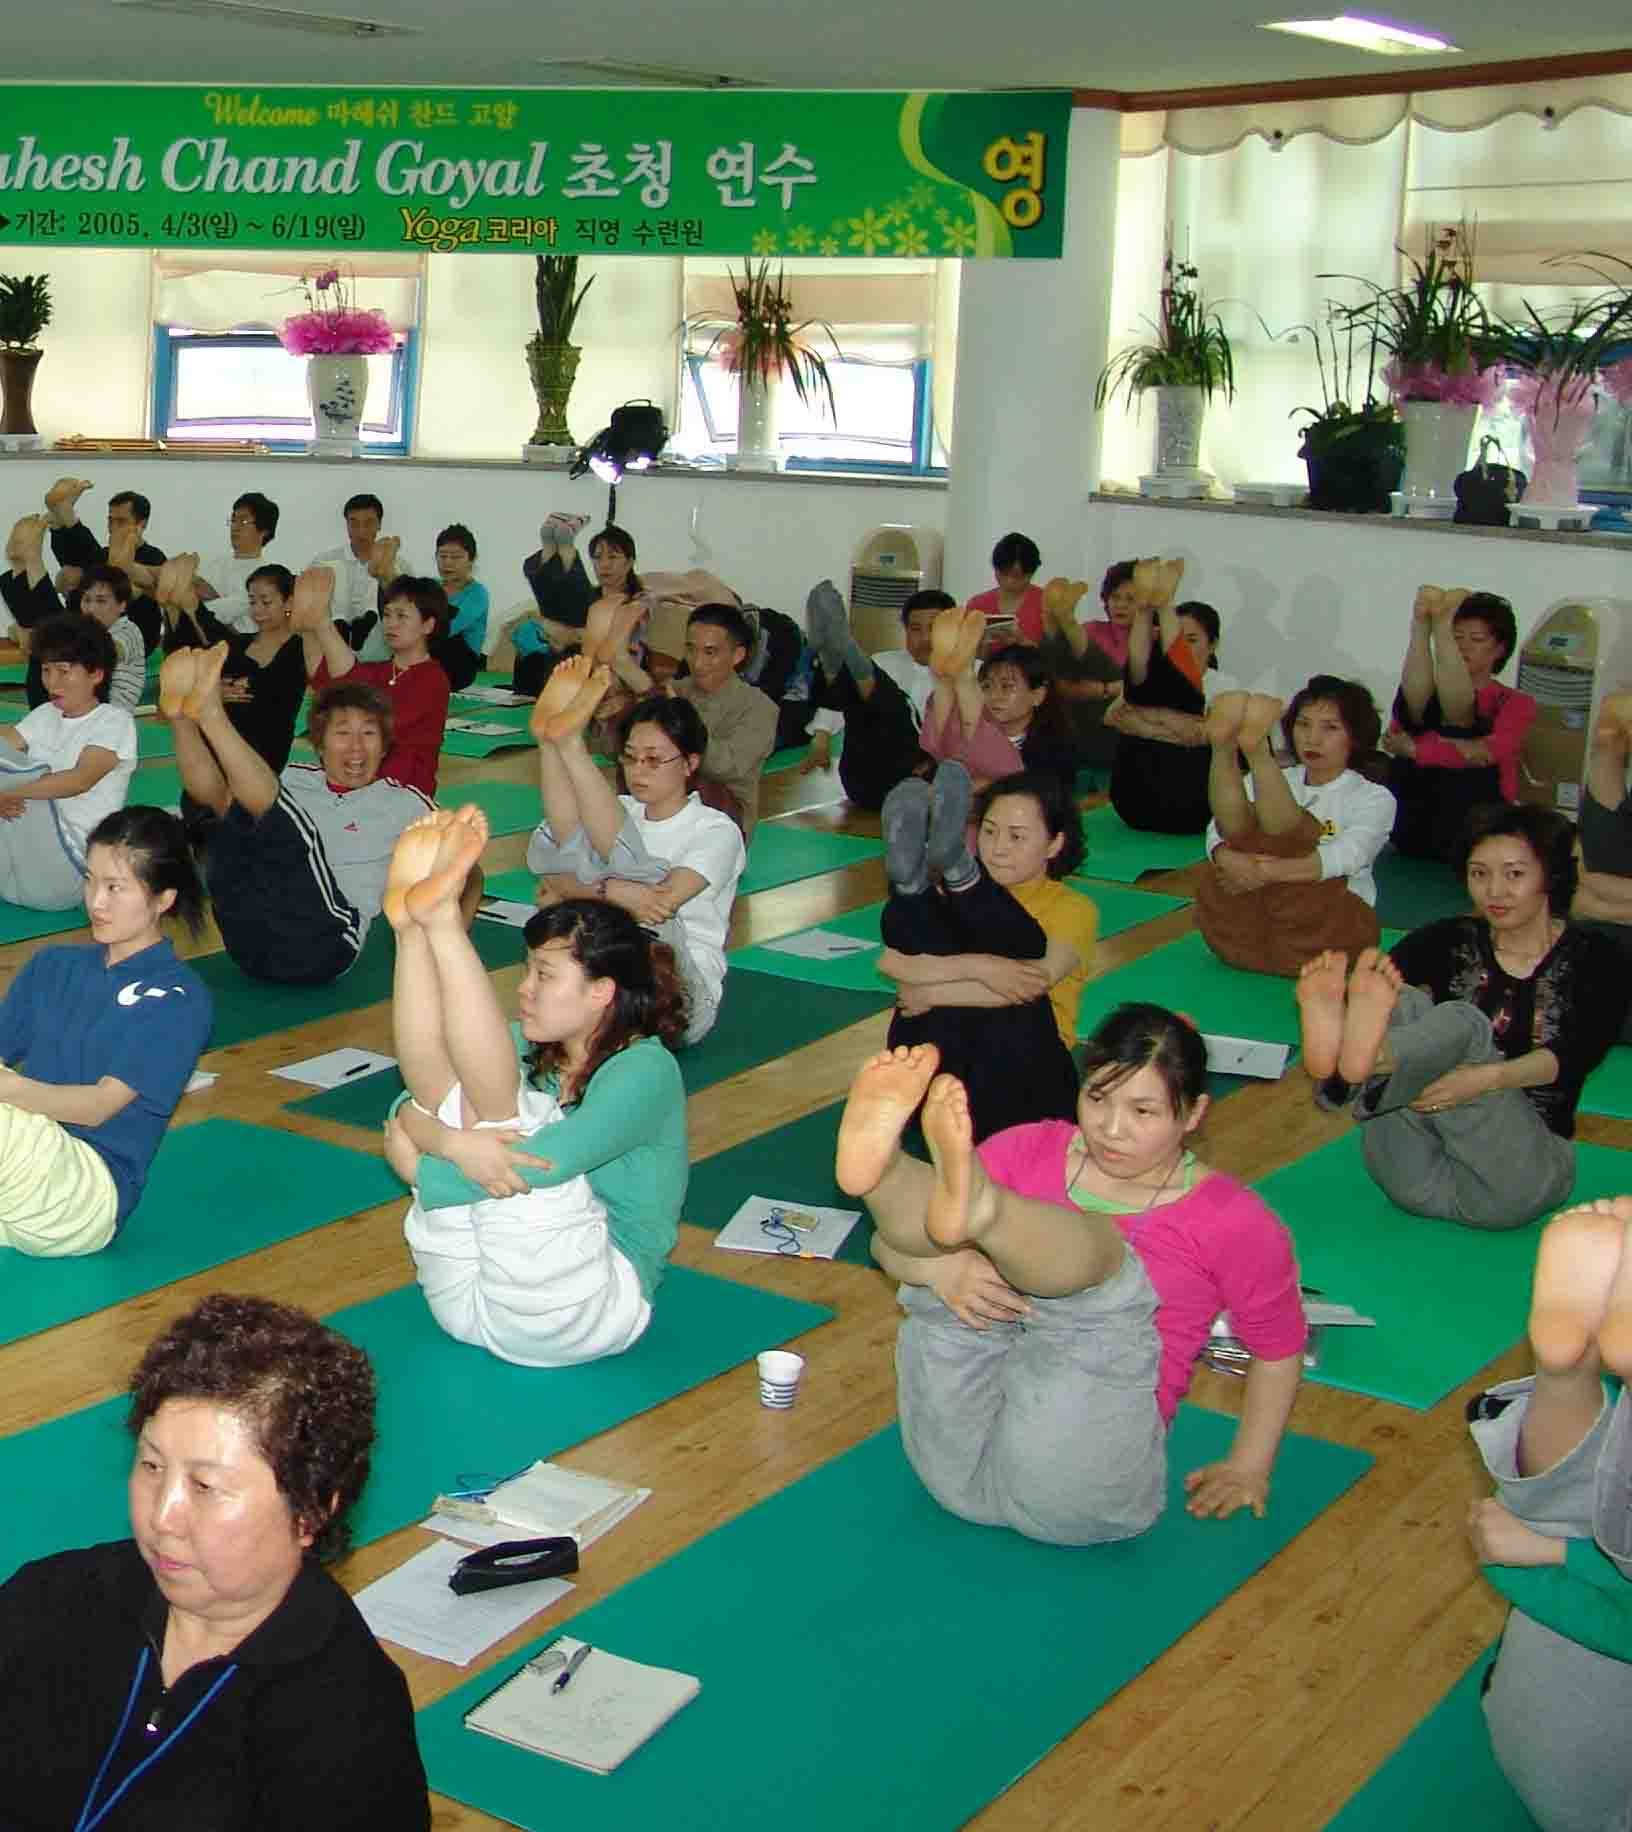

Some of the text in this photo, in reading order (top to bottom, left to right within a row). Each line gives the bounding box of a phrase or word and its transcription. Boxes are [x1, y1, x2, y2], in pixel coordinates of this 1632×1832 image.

[204, 92, 319, 126] Welcome
[160, 137, 363, 195] Chand
[375, 139, 550, 209] Goyal
[561, 140, 673, 209] 초청
[705, 141, 818, 210] 연수
[981, 130, 1048, 230] 영
[160, 212, 239, 240] 4/3(일)
[271, 213, 367, 241] 6/19(일)
[575, 217, 620, 245] 직영
[632, 218, 705, 248] 수련원
